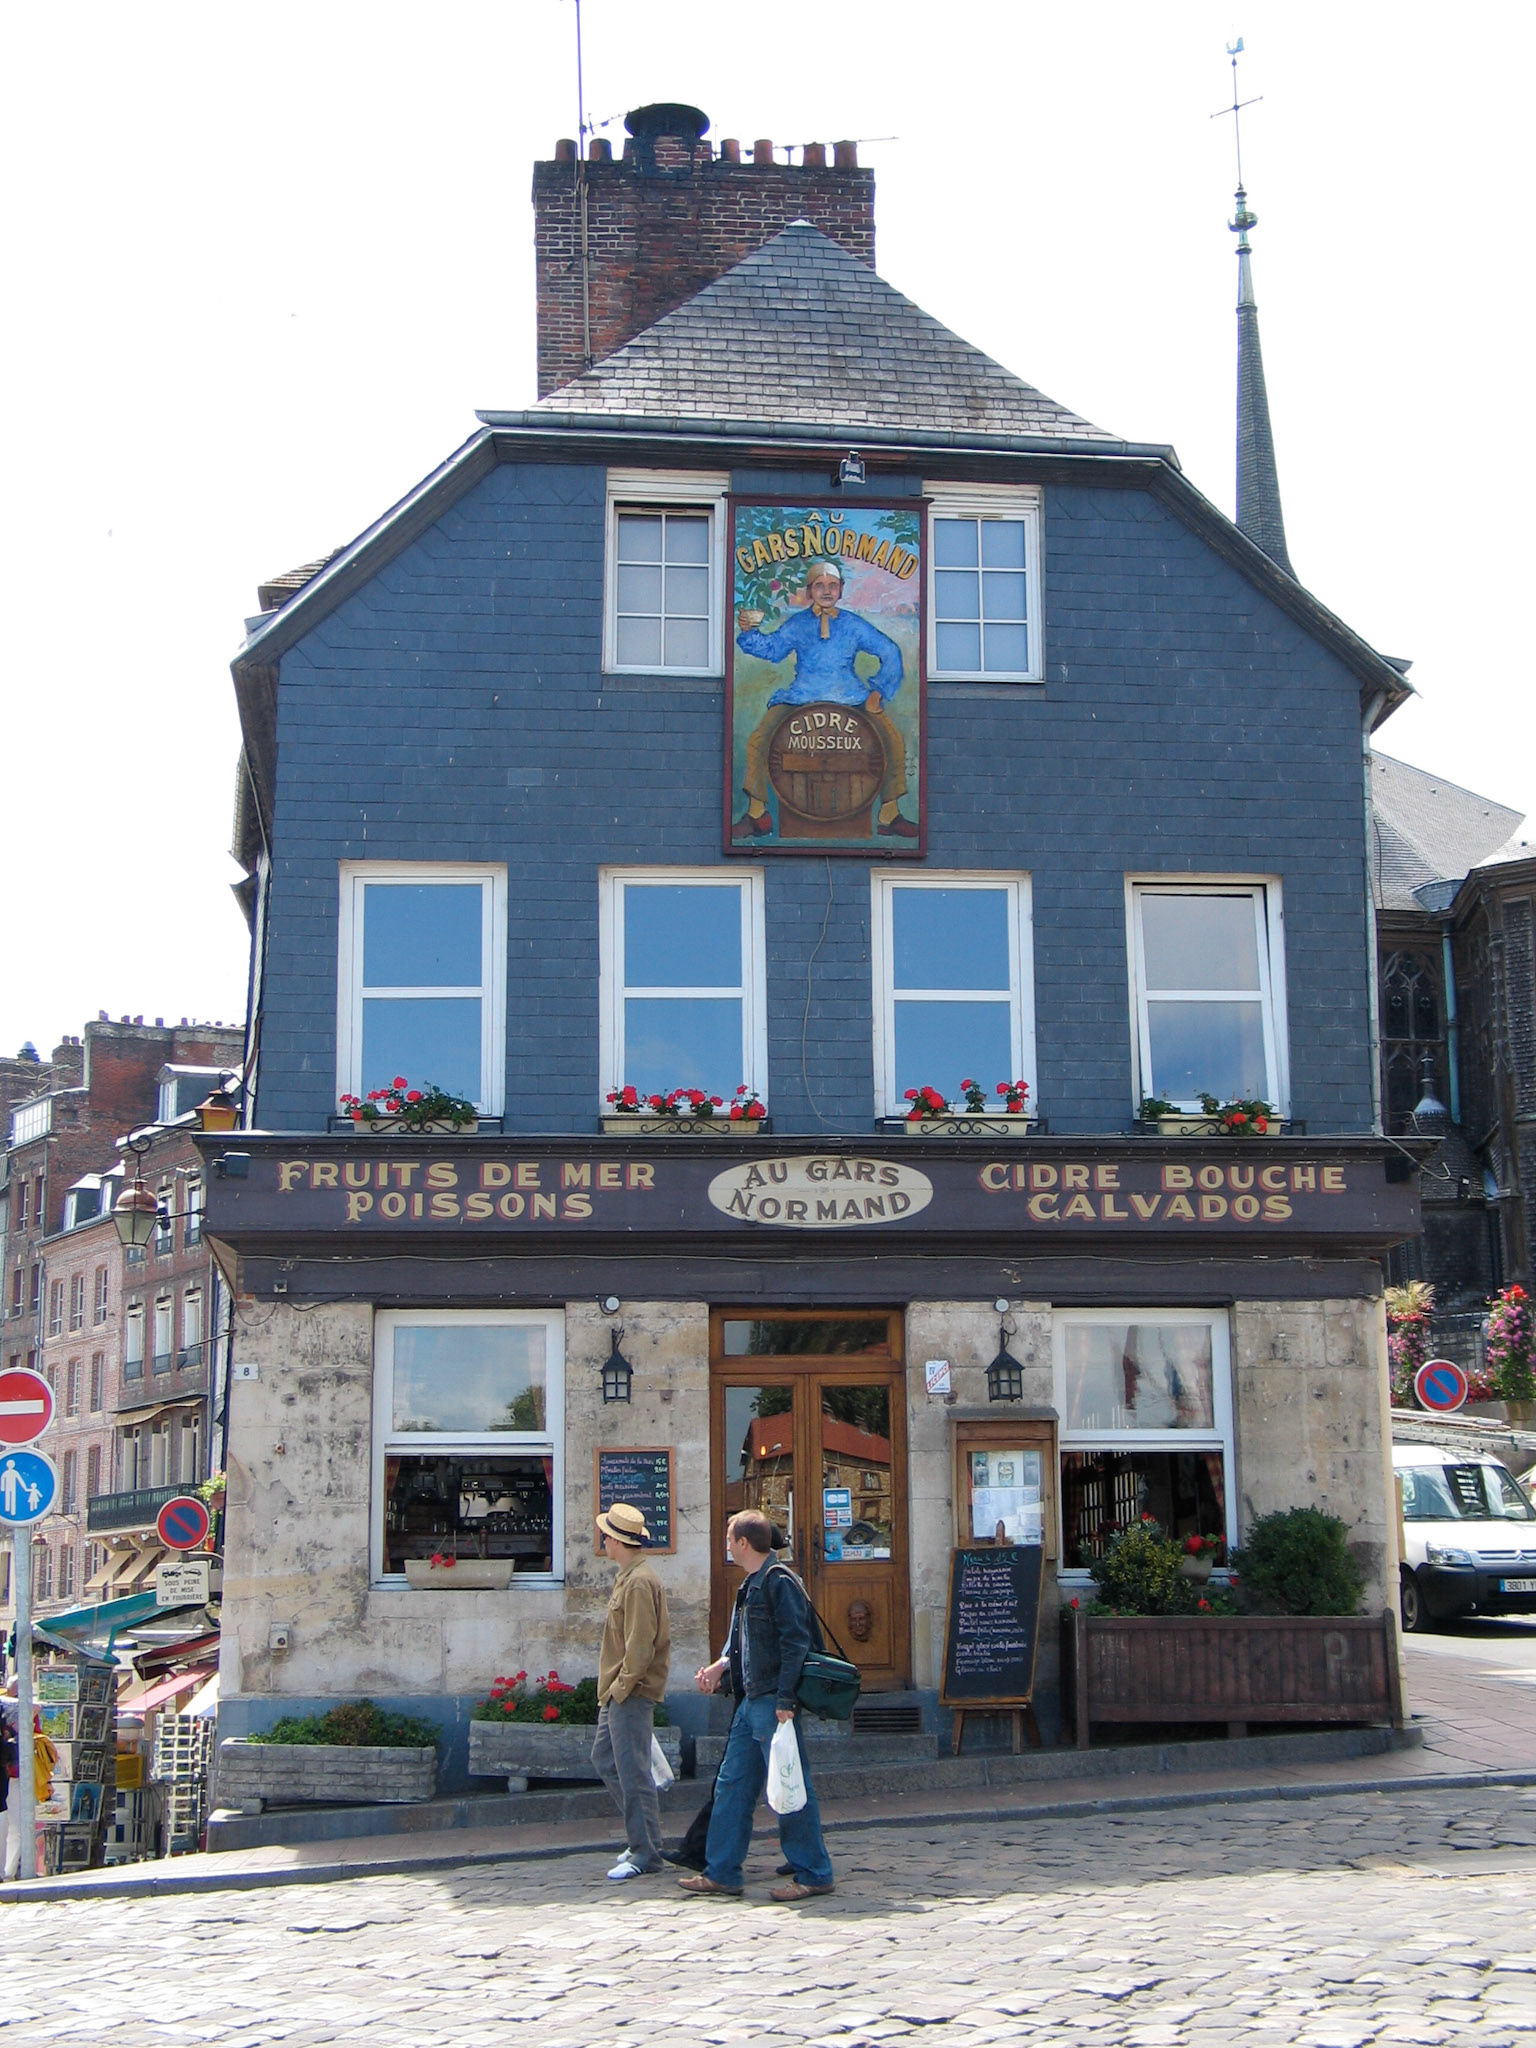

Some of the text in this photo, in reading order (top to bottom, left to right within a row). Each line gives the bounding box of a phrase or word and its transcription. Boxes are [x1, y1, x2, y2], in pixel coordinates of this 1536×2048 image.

[808, 511, 844, 524] AU
[736, 524, 919, 580] GARS NORMAND
[789, 713, 858, 735] CIDRE
[788, 736, 861, 749] MOUSSEUX
[277, 1161, 655, 1191] FRUITS DE MER
[741, 1158, 900, 1190] AU GARS
[980, 1163, 1347, 1193] CIDRE BOUCHE
[346, 1191, 594, 1222] POISSONS
[726, 1188, 911, 1220] NORMAND
[1027, 1193, 1294, 1222] CALVADOS
[243, 1367, 250, 1376] 8
